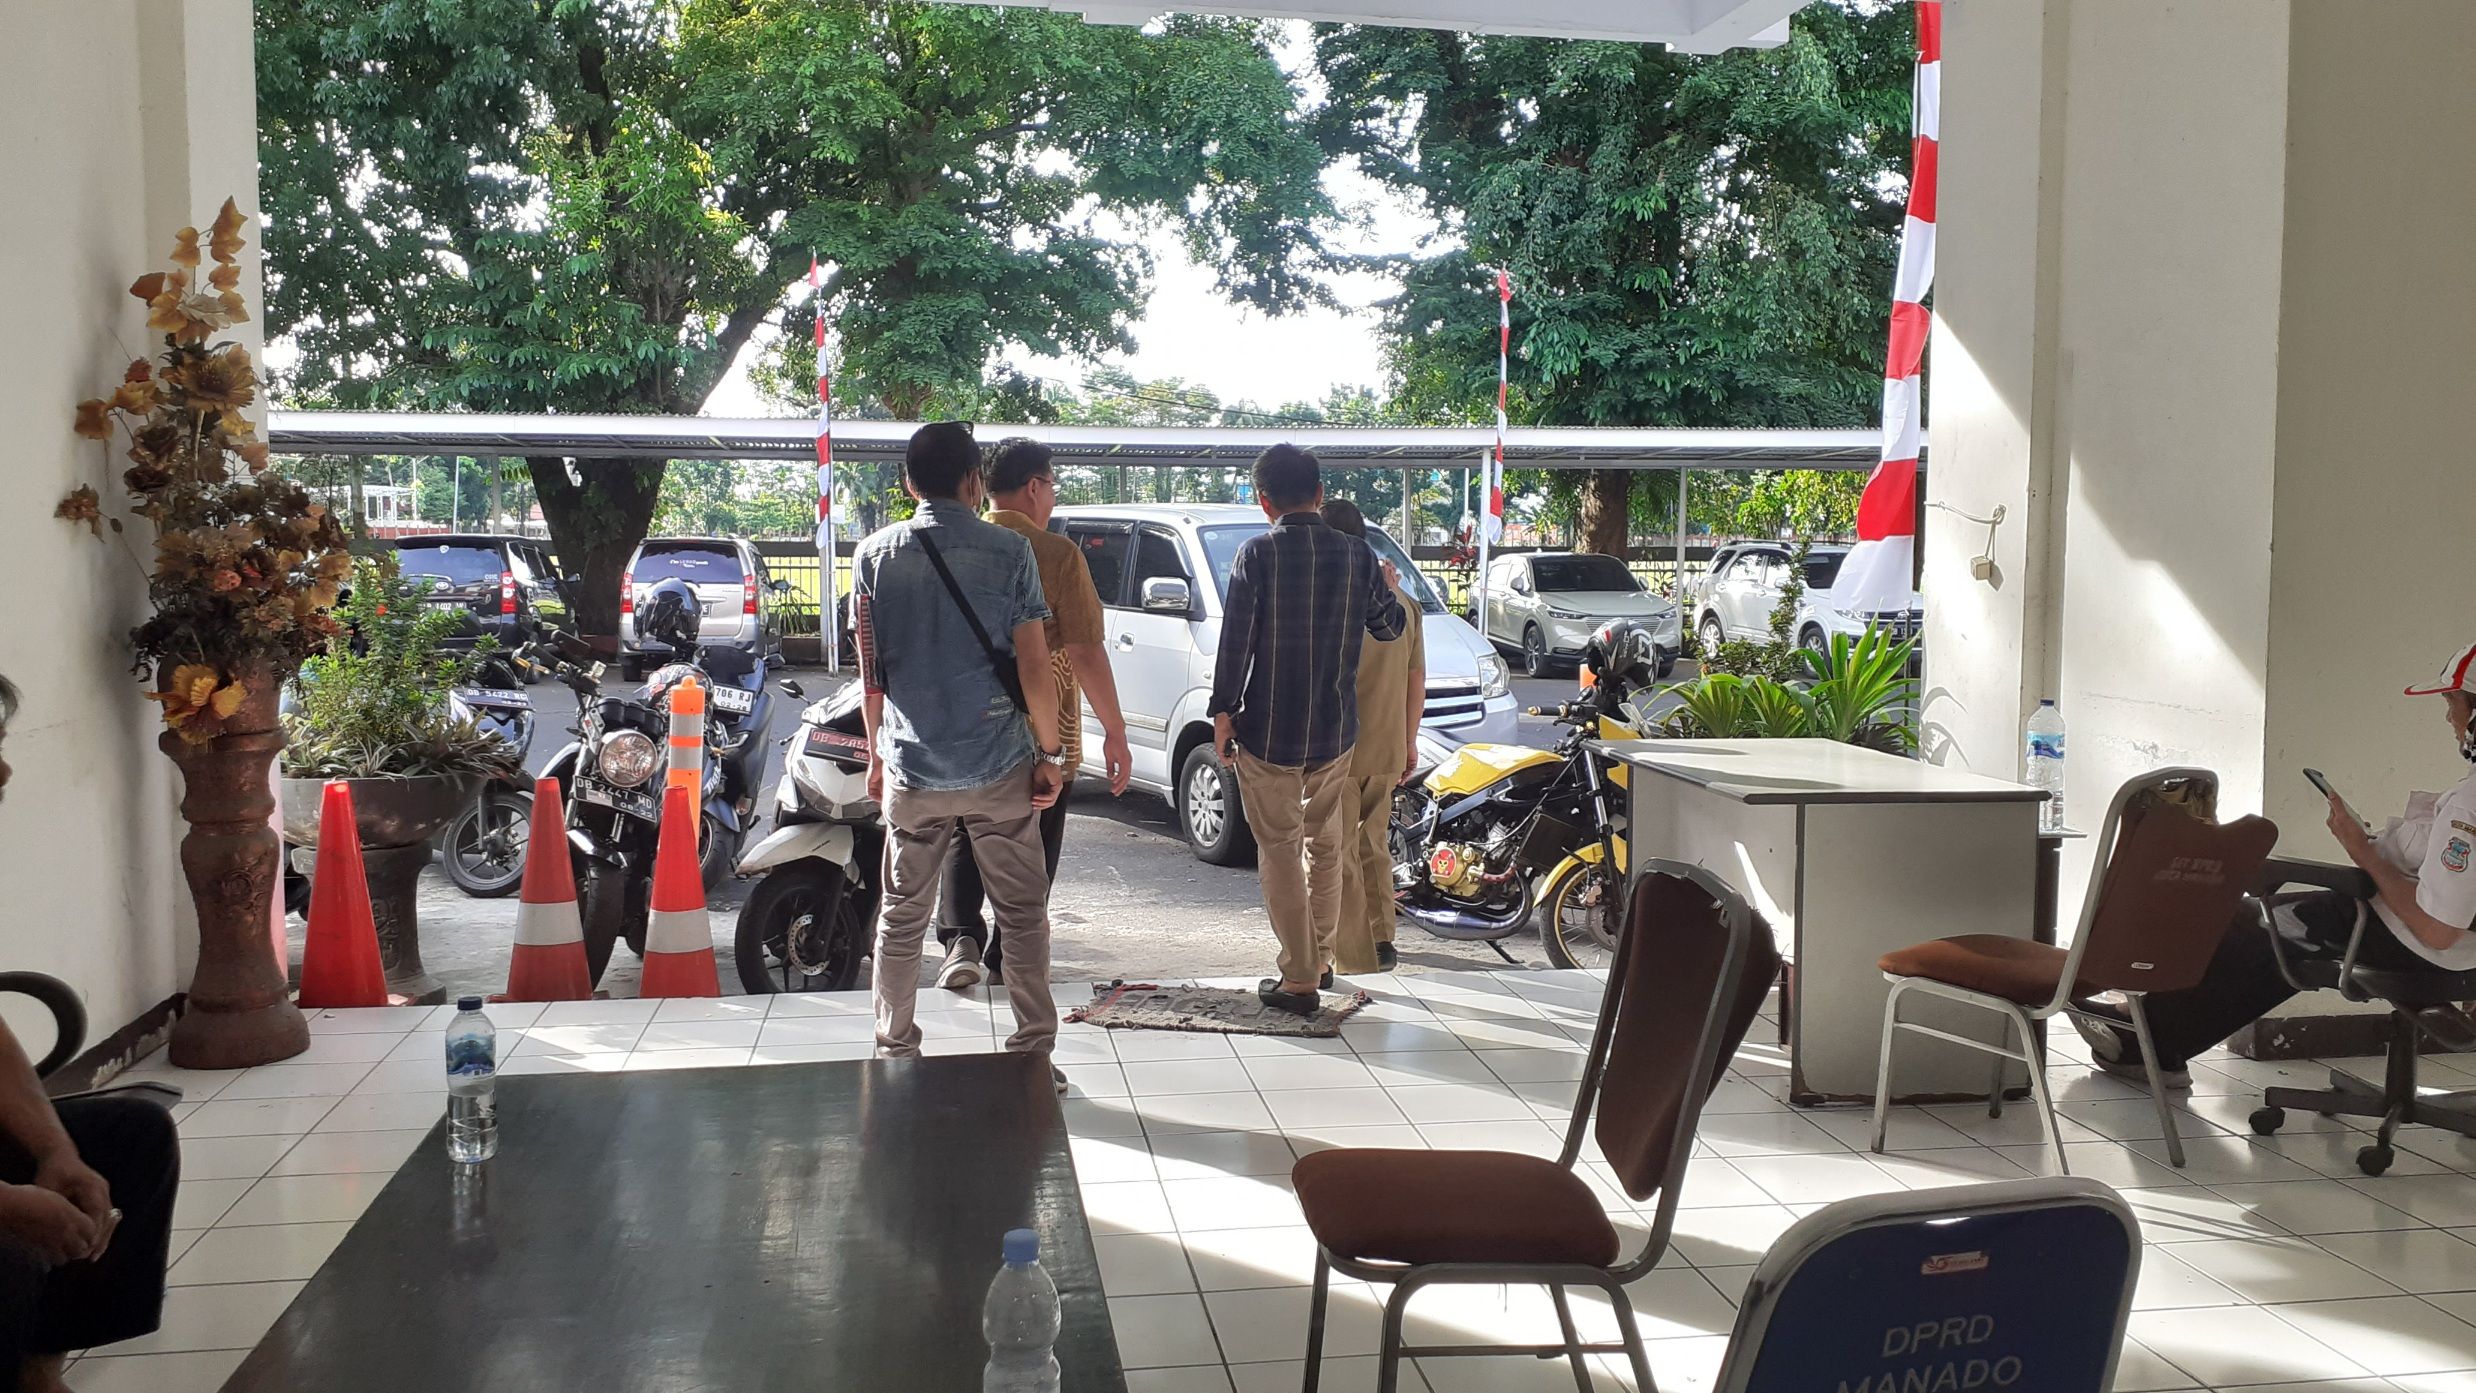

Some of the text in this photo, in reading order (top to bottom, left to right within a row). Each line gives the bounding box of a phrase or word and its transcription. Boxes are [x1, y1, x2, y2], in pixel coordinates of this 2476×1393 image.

[739, 692, 751, 703] RJ
[812, 731, 829, 743] DB
[576, 777, 593, 790] DB
[599, 785, 629, 800] 2447
[1881, 1313, 1996, 1358] DPRD
[1836, 1354, 2024, 1393] MANADO
